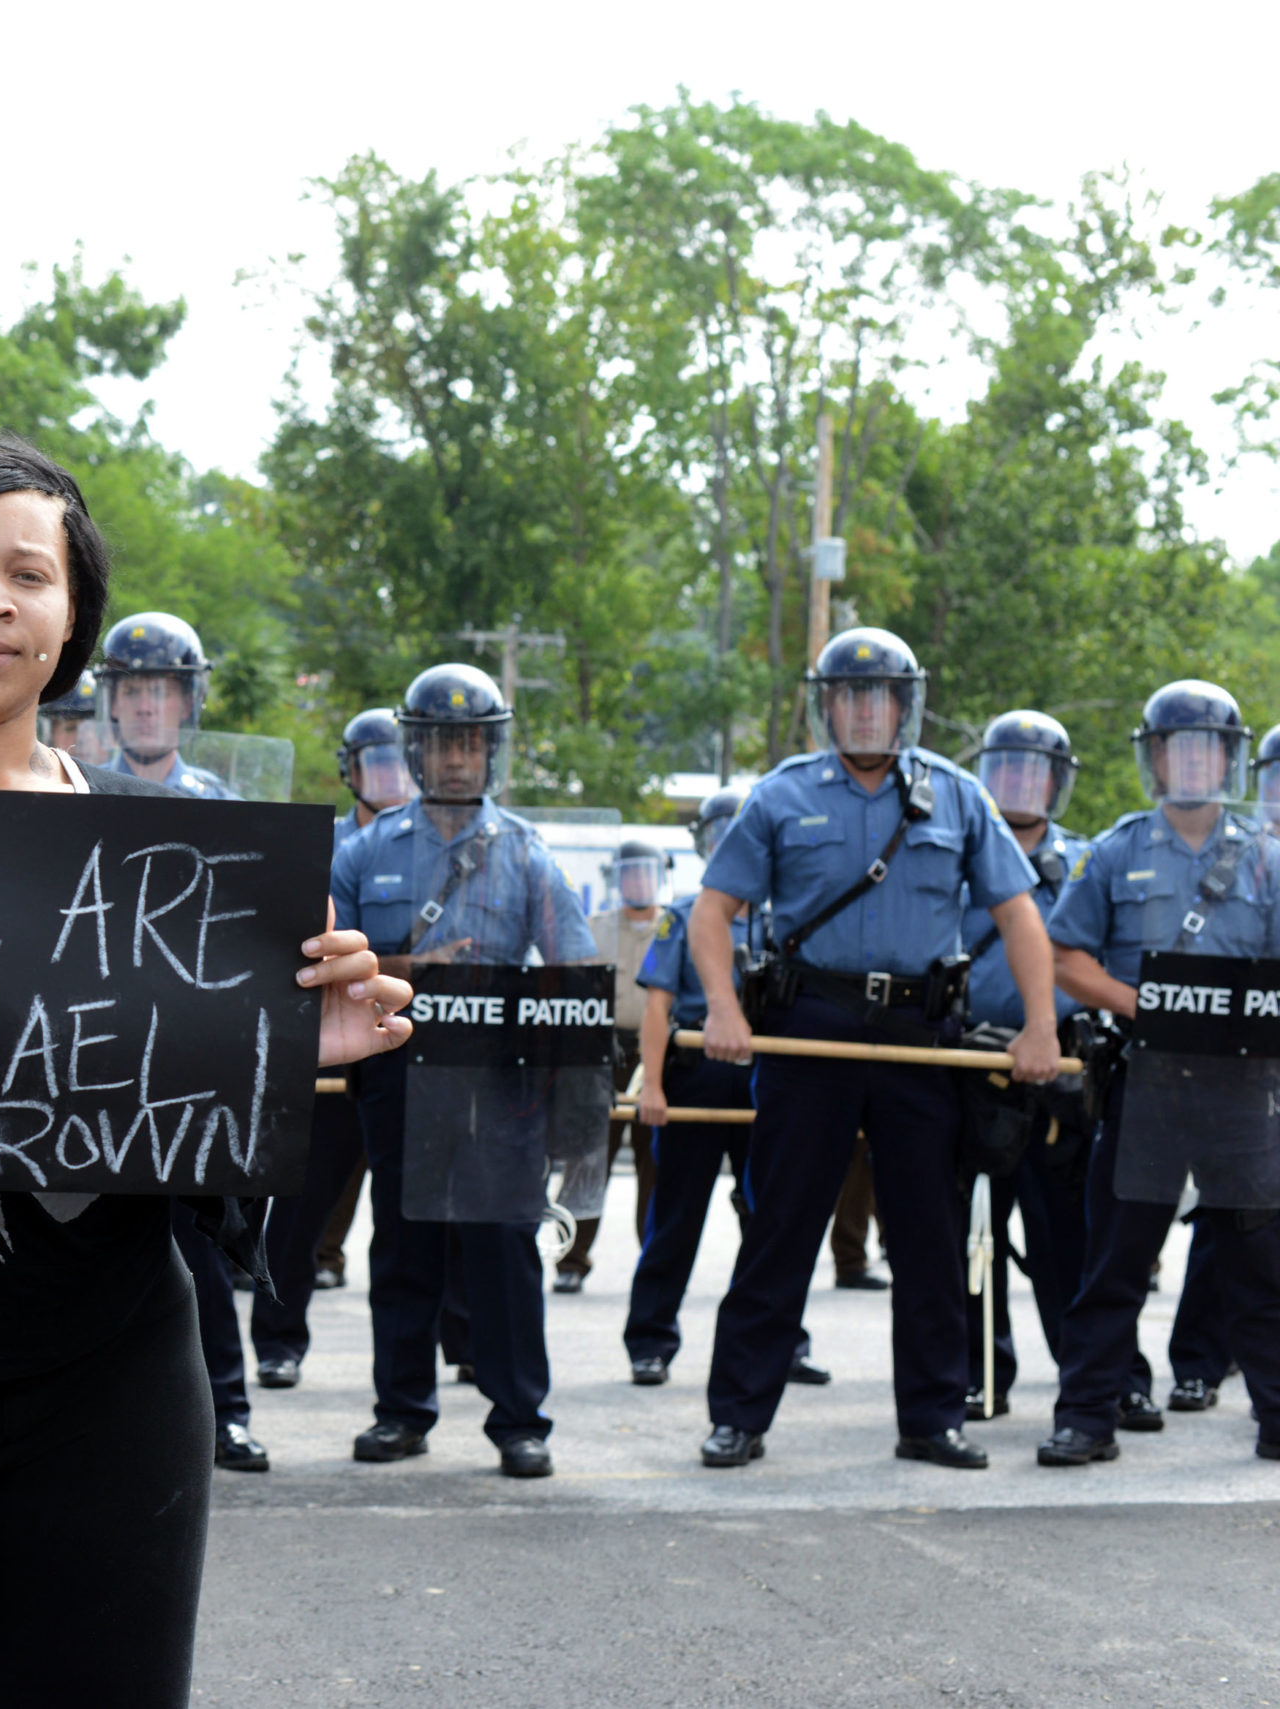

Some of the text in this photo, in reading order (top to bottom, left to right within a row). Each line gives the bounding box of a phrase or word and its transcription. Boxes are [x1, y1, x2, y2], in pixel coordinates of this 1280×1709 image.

[50, 838, 264, 989] ARE
[411, 993, 615, 1026] STATE PATROL
[1138, 981, 1232, 1015] STATE
